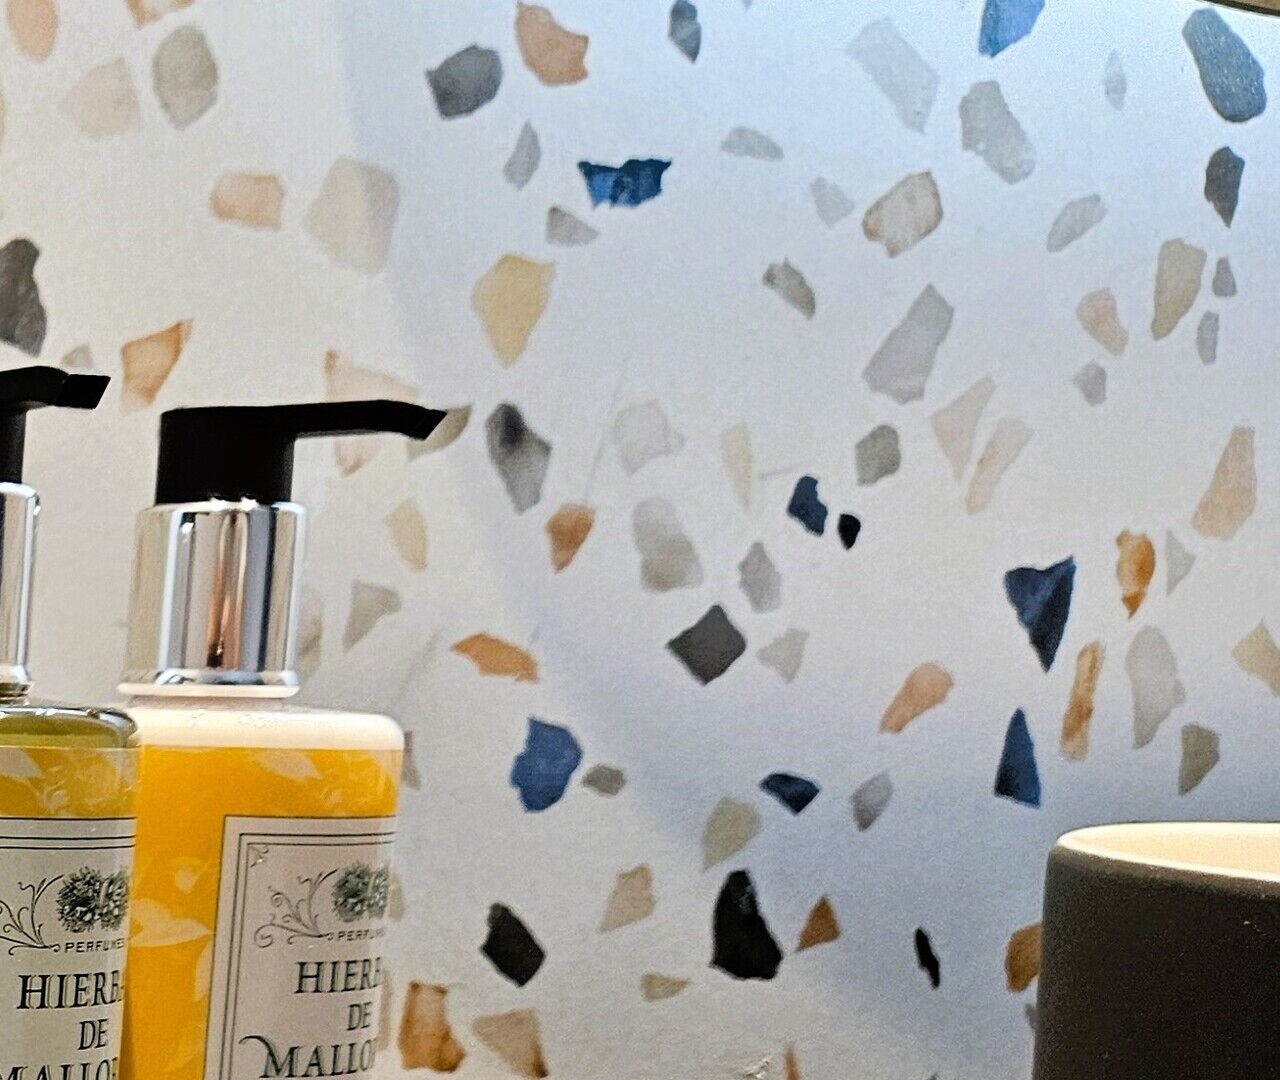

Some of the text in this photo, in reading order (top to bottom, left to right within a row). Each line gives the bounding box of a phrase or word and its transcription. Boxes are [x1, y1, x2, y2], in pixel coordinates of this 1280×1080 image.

[16, 970, 124, 1010] HIERB
[294, 957, 380, 994] HIER
[78, 1018, 109, 1051] DE
[346, 1001, 373, 1031] DE
[238, 1035, 377, 1079] MALLO
